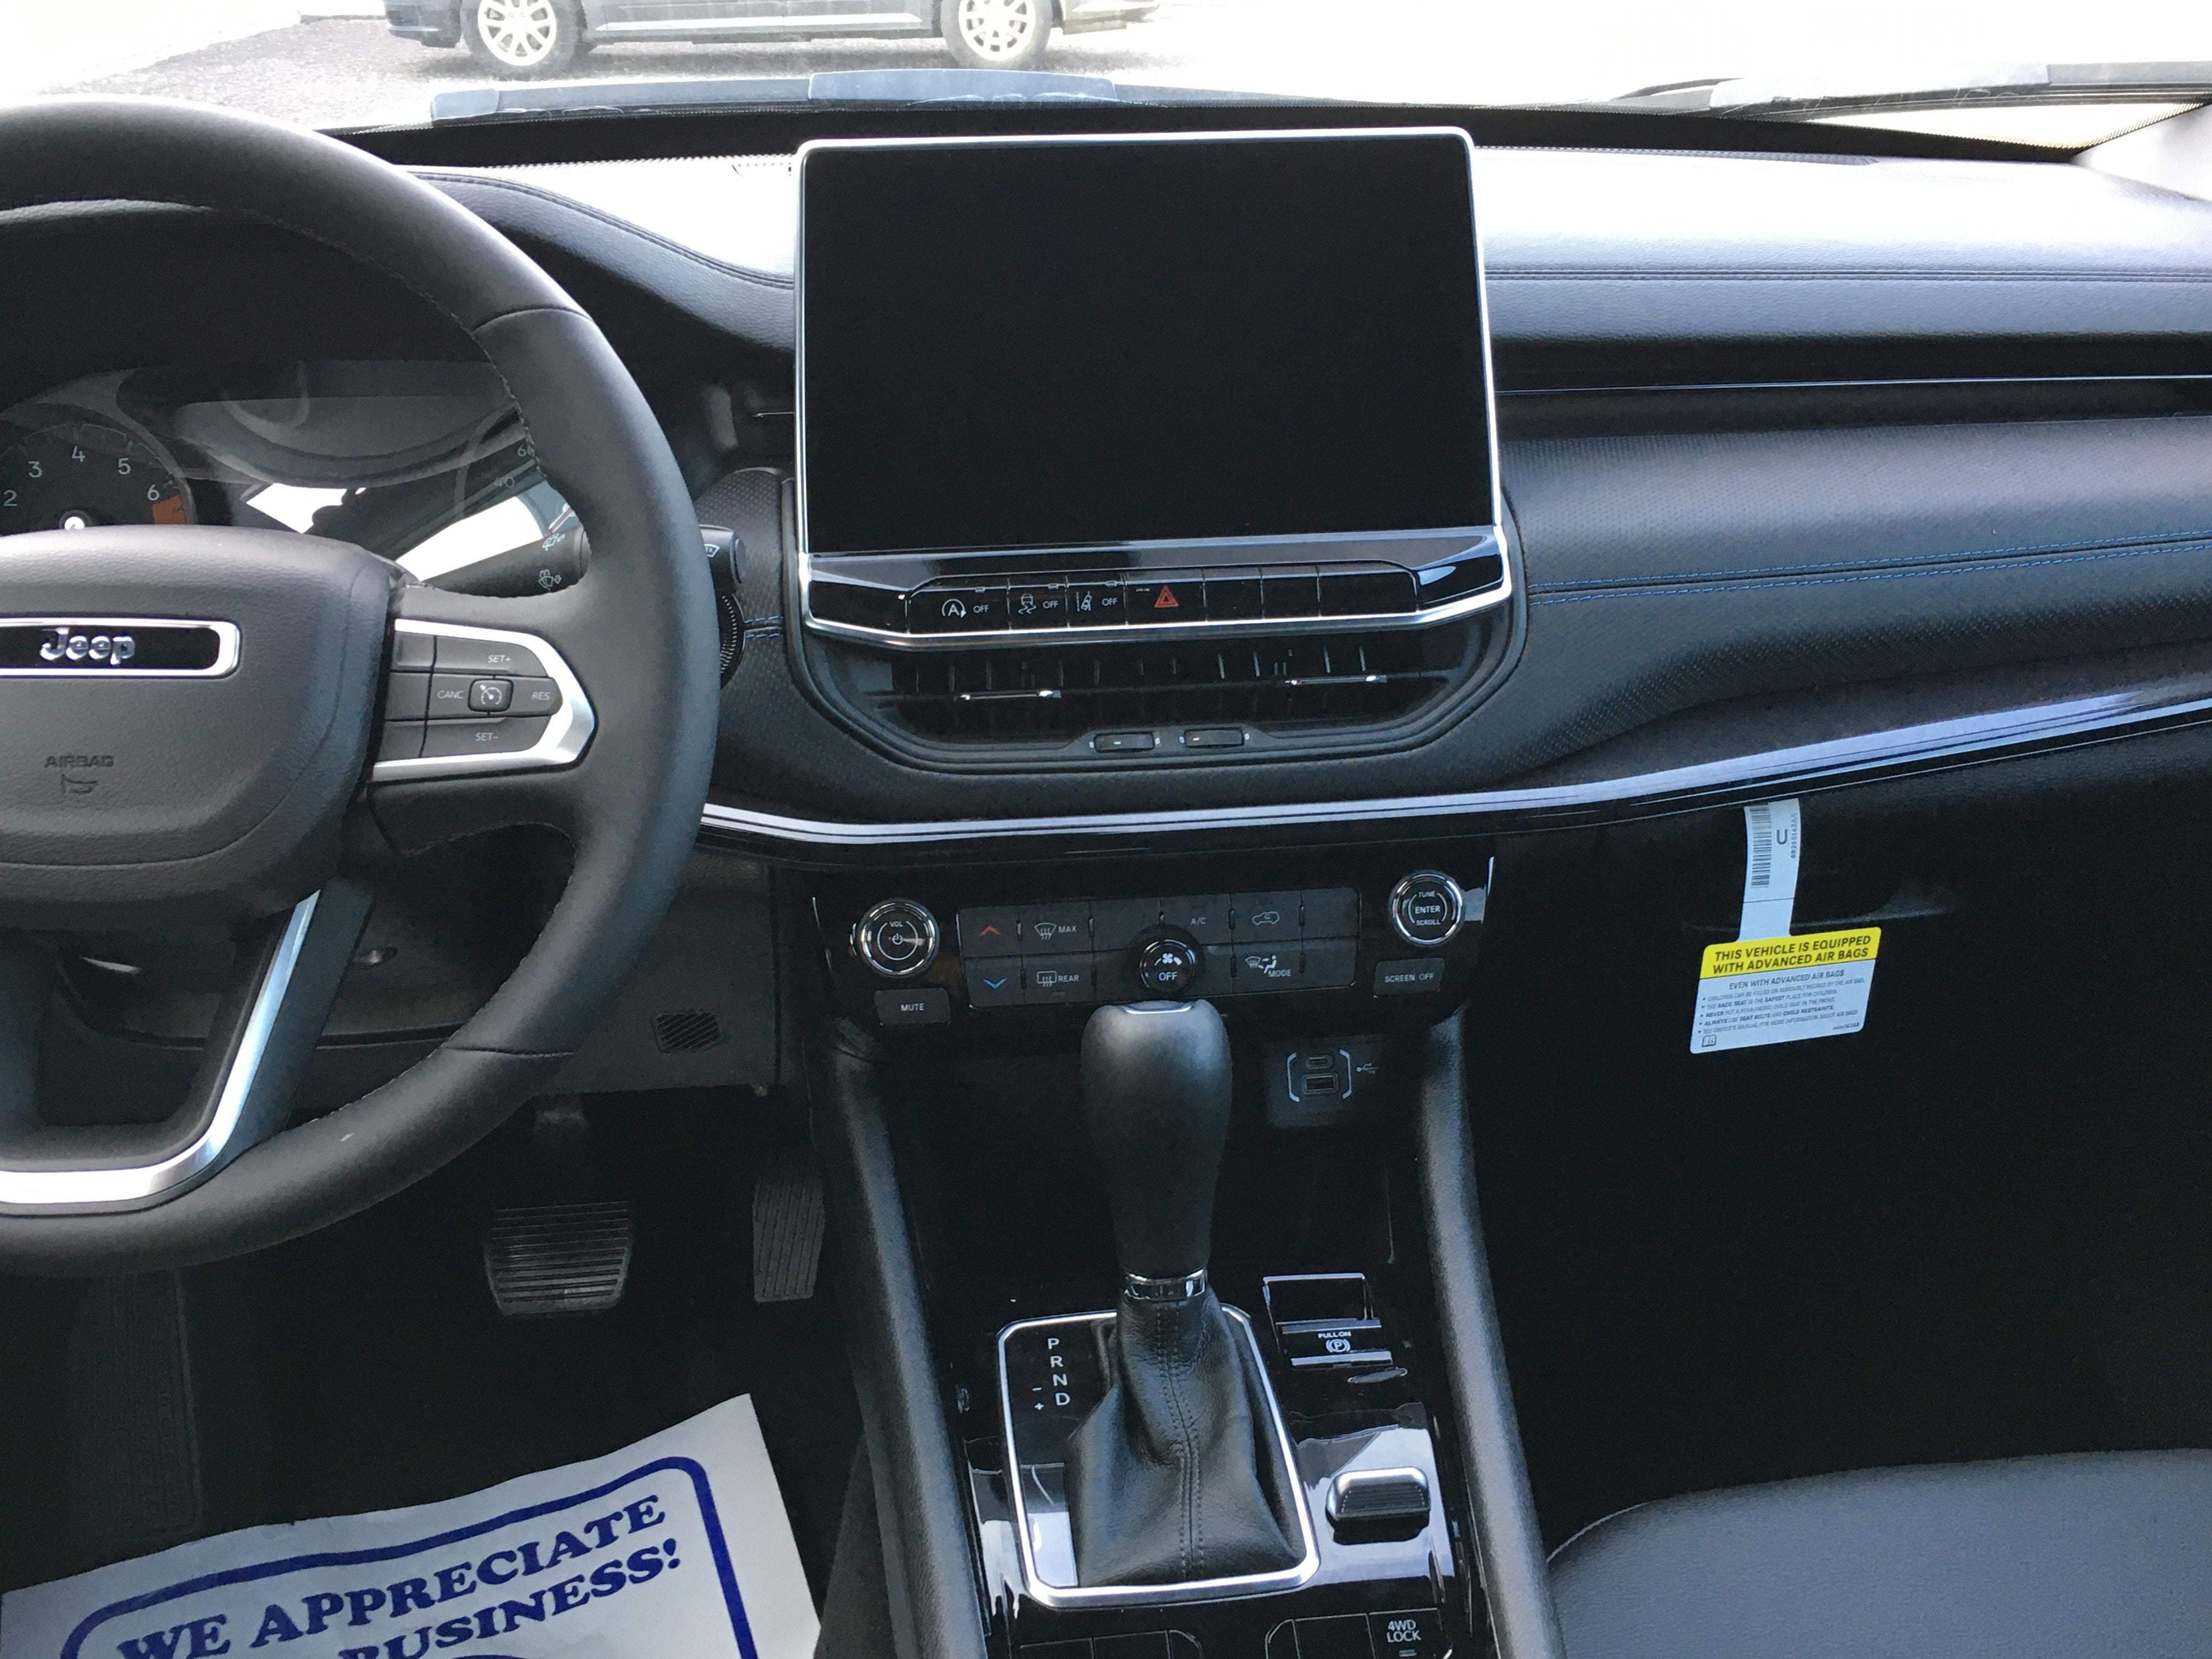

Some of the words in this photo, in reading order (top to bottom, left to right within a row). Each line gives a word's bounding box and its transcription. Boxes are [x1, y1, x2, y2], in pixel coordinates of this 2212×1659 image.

[72, 445, 86, 462] 4
[28, 461, 42, 478] 3
[118, 458, 131, 475] 5
[3, 490, 18, 506] 2
[147, 484, 160, 501] 6
[1042, 600, 1058, 609] OFF
[1102, 598, 1118, 606] OFF
[973, 605, 989, 613] OFF
[40, 628, 136, 665] Jeep
[437, 691, 464, 699] CANC
[532, 691, 550, 700] RES
[44, 755, 115, 768] AIRBAG
[1776, 829, 1788, 845] U
[1415, 905, 1440, 914] ENTER
[1191, 917, 1206, 925] A/C
[1058, 925, 1076, 933] MAX
[1715, 950, 1742, 961] THIS
[1746, 944, 1796, 958] VEHICLE
[1798, 942, 1809, 952] IS
[1813, 935, 1871, 950] EQUIPPED
[1713, 962, 1743, 974] WITH
[1747, 955, 1812, 970] ADVANCED
[1815, 952, 1835, 963] AIR
[1838, 947, 1869, 960] BAGS
[1058, 974, 1079, 983] REAR
[1159, 972, 1177, 981] OFF
[1268, 969, 1291, 977] MODE
[1384, 973, 1415, 983] SCREEN
[1419, 972, 1434, 980] OFF
[1729, 981, 1748, 990] EVEN
[1770, 974, 1810, 985] ADVANCED
[1825, 969, 1844, 978] BAGS
[900, 1003, 924, 1012] MUTE
[1047, 1338, 1059, 1350] P
[1050, 1356, 1064, 1368] R
[1053, 1374, 1068, 1386] N
[1055, 1392, 1070, 1406] D
[117, 1613, 231, 1659] WE
[251, 1495, 665, 1647] APPRECIATE
[1387, 1620, 1416, 1632] 4WD
[1386, 1630, 1421, 1643] LOCK
